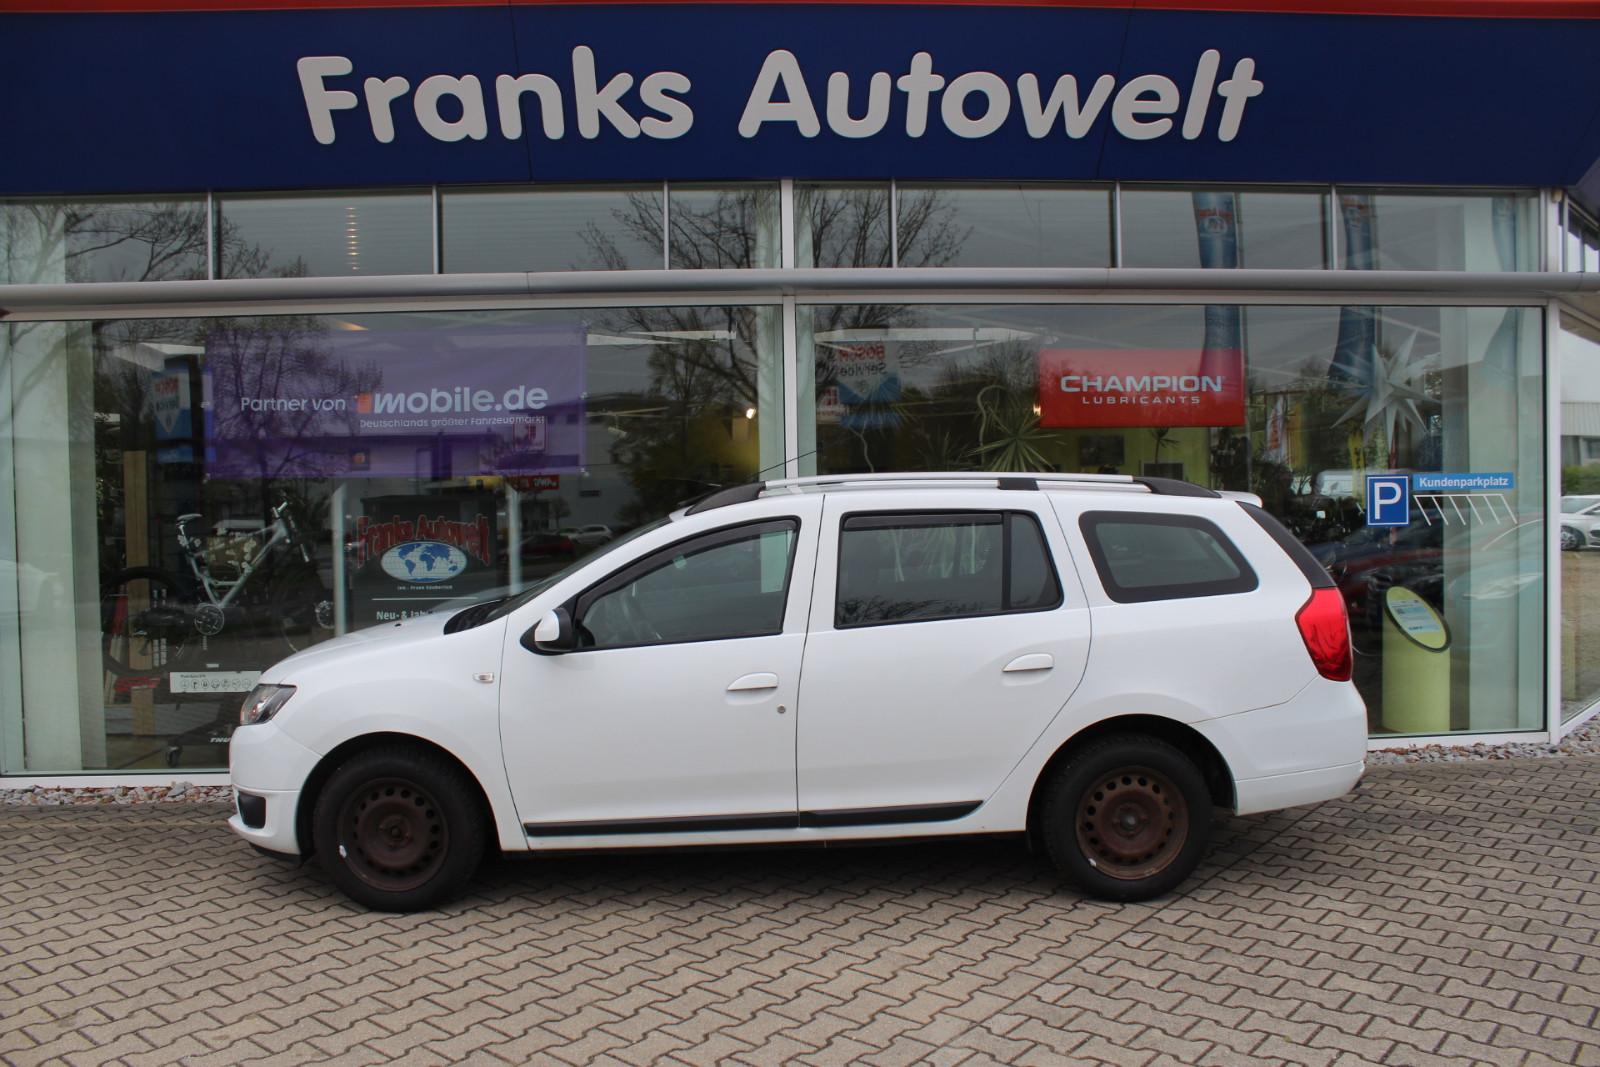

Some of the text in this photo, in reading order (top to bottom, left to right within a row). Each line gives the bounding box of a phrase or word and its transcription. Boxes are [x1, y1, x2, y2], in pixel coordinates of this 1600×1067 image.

[297, 45, 1264, 145] Franks Autowelt
[1061, 375, 1222, 392] CHAMPION
[240, 385, 548, 414] Partner von mobile.de
[1083, 396, 1200, 404] LUBRICANTS
[359, 418, 428, 429] Deutschlands
[1419, 476, 1509, 488] Kundenparkplatz
[1374, 482, 1401, 520] P
[376, 611, 399, 620] Neu-
